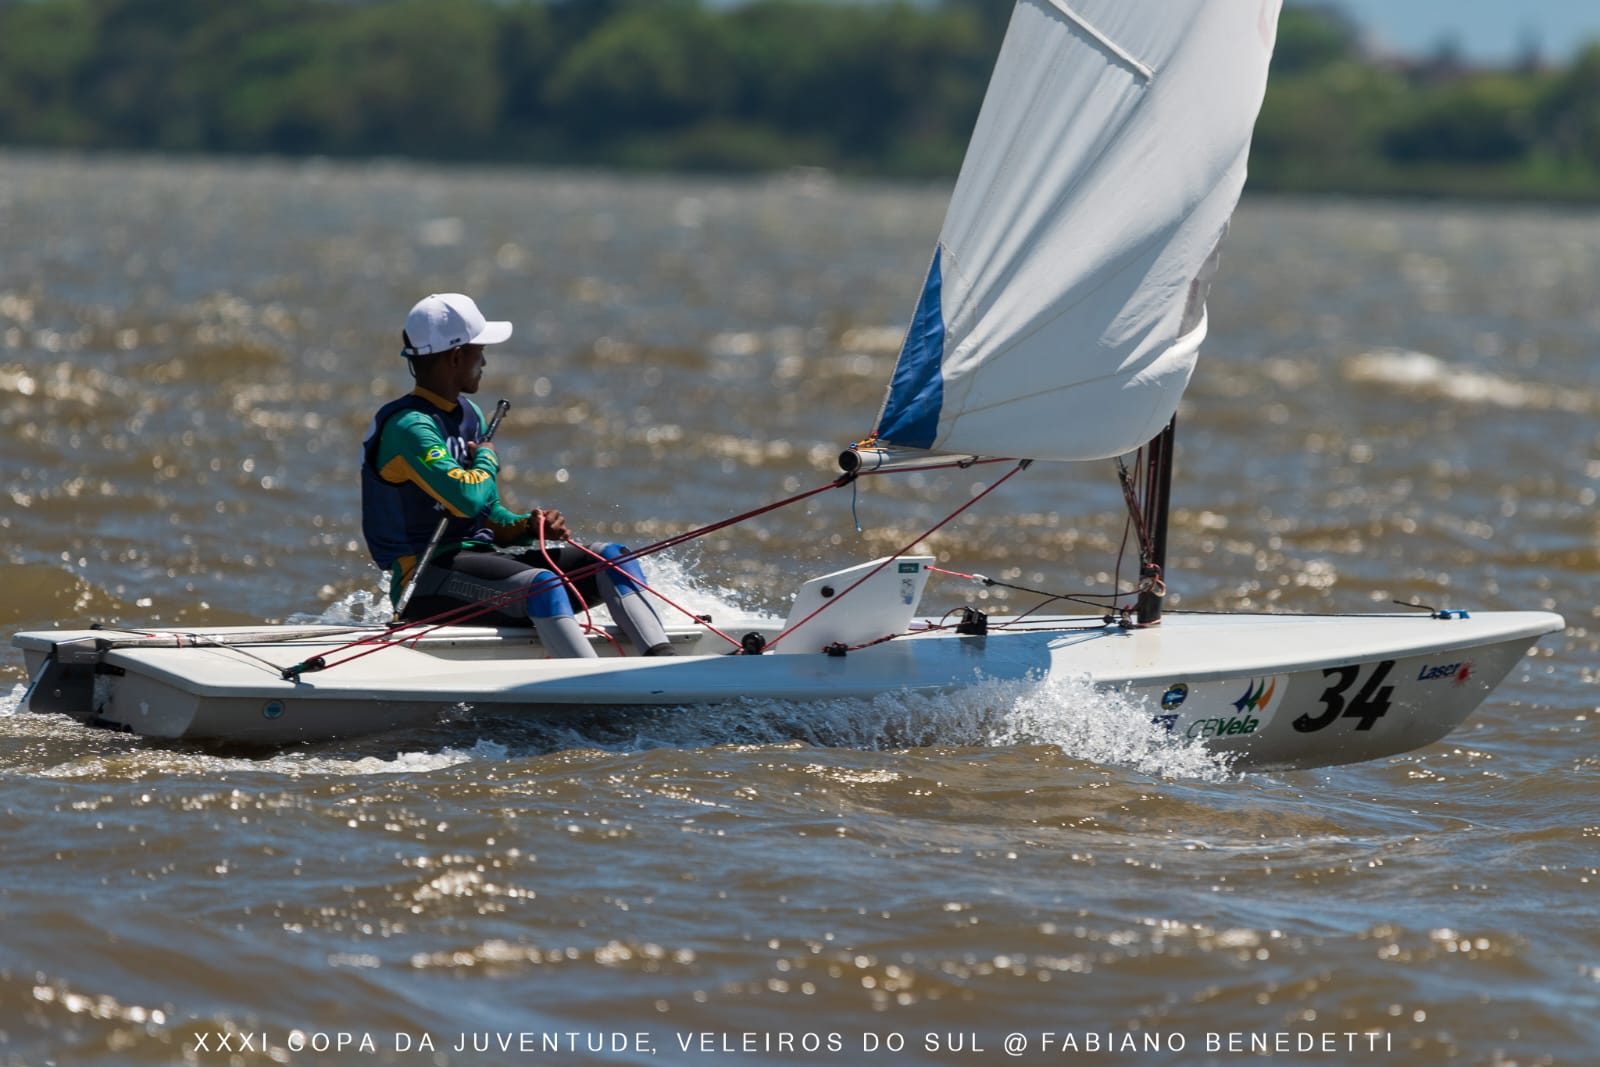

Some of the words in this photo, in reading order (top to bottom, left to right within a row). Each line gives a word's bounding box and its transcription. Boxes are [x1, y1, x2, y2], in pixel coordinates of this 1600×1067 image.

[1416, 663, 1461, 681] Laser
[1292, 660, 1396, 733] 34
[1186, 714, 1259, 739] CBVela
